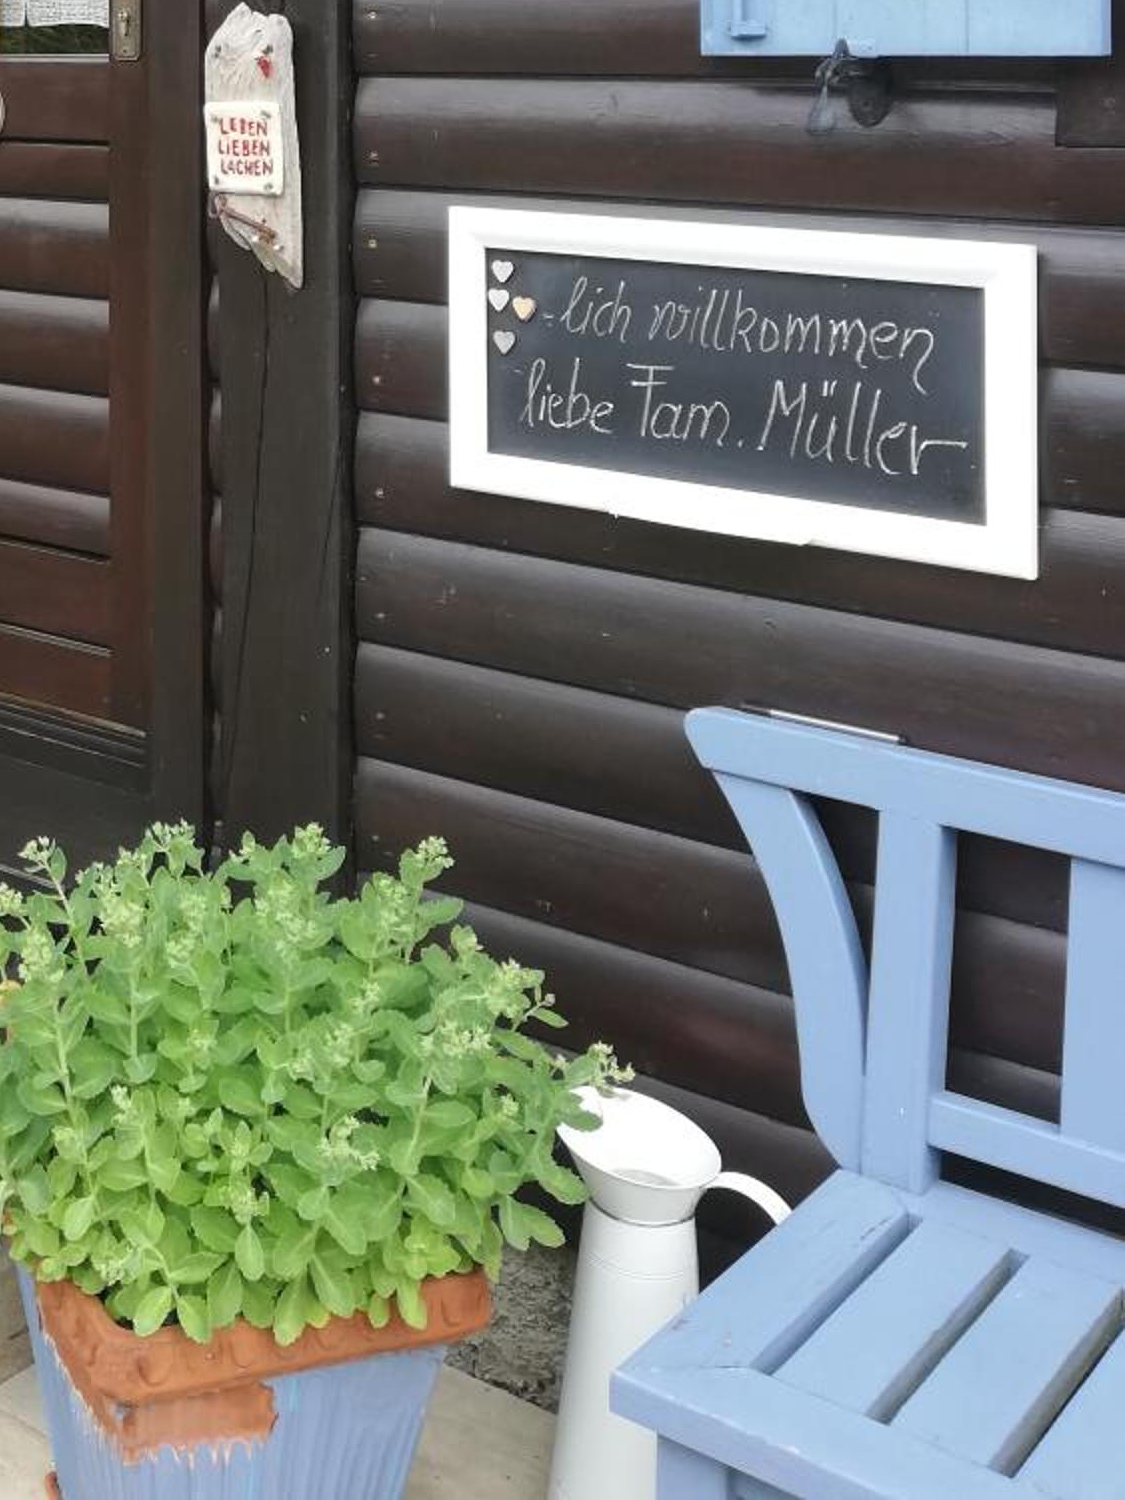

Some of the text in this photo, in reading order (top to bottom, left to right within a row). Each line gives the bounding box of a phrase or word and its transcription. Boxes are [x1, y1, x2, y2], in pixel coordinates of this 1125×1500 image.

[218, 117, 268, 137] LEBEN
[220, 158, 274, 177] LACHEN
[648, 284, 935, 396] willkommen
[520, 357, 969, 476] liebe Fam. Müller
